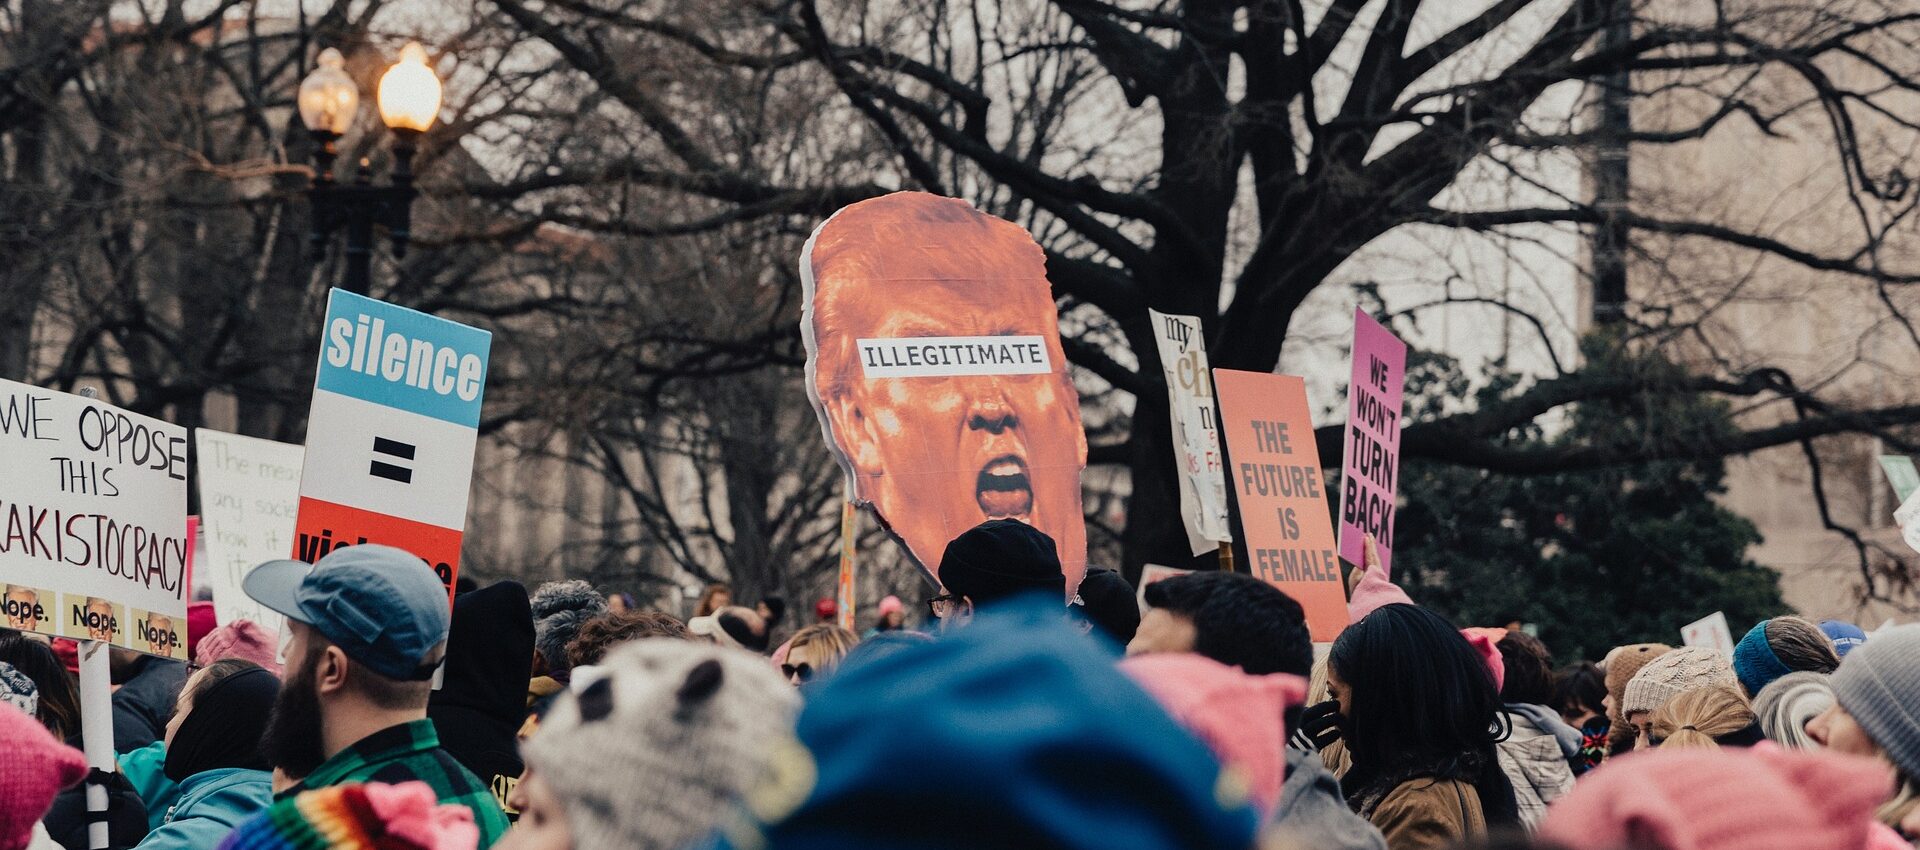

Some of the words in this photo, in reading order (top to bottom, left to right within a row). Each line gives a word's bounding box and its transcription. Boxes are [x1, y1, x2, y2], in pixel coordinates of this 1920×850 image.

[1164, 316, 1193, 354] my
[327, 313, 482, 401] silence
[865, 343, 1043, 367] ILLEGITIMATE
[1370, 353, 1388, 393] WE
[1356, 385, 1396, 442] WON'T
[0, 393, 59, 441] WE
[79, 406, 186, 480] OPPOSE
[1251, 420, 1292, 454] THE
[208, 440, 249, 474] The
[1352, 427, 1392, 494] TURN
[50, 457, 119, 497] THIS
[1240, 463, 1320, 498] FUTURE
[1277, 507, 1300, 540] IS
[1344, 475, 1392, 549] BACK
[1255, 549, 1338, 582] FEMALE
[72, 604, 121, 635] Nope.
[138, 618, 182, 650] Nope.
